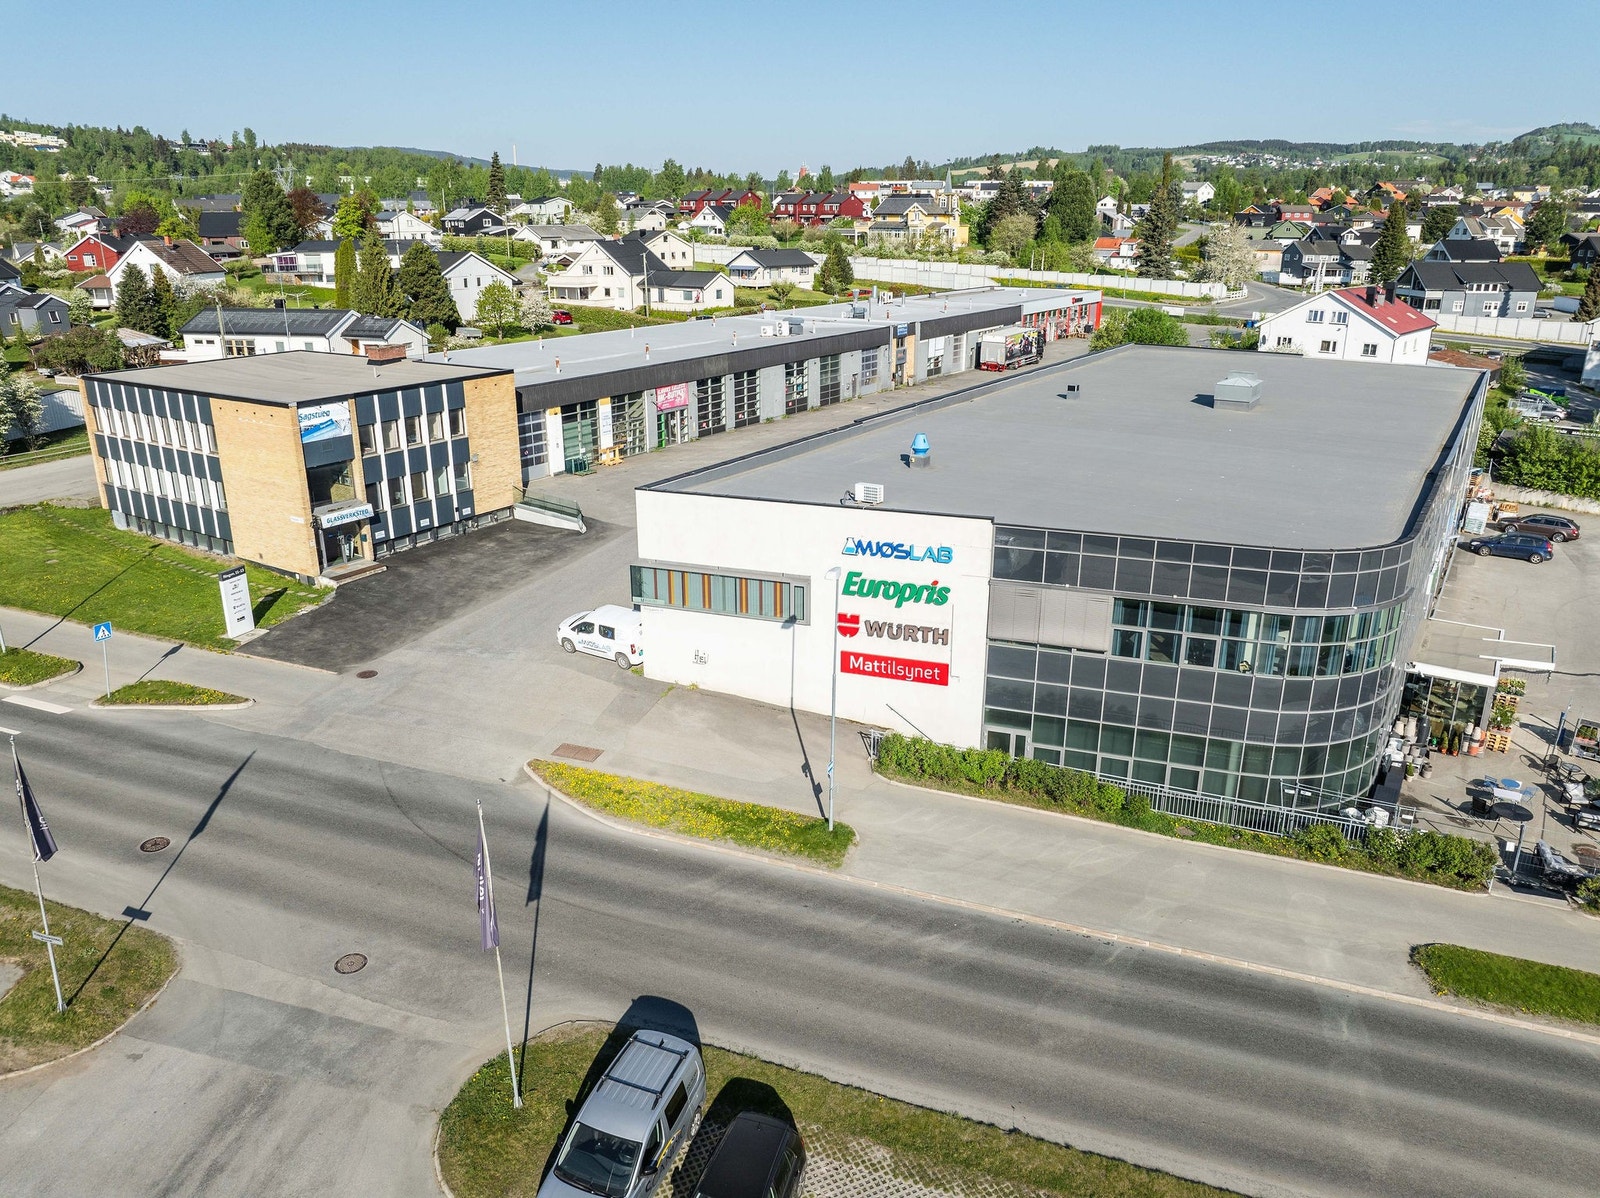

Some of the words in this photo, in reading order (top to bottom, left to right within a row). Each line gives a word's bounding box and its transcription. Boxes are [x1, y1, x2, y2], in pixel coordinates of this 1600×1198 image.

[841, 571, 951, 608] Europris
[864, 619, 949, 646] WÜRTH
[849, 655, 940, 681] Mattilsynet
